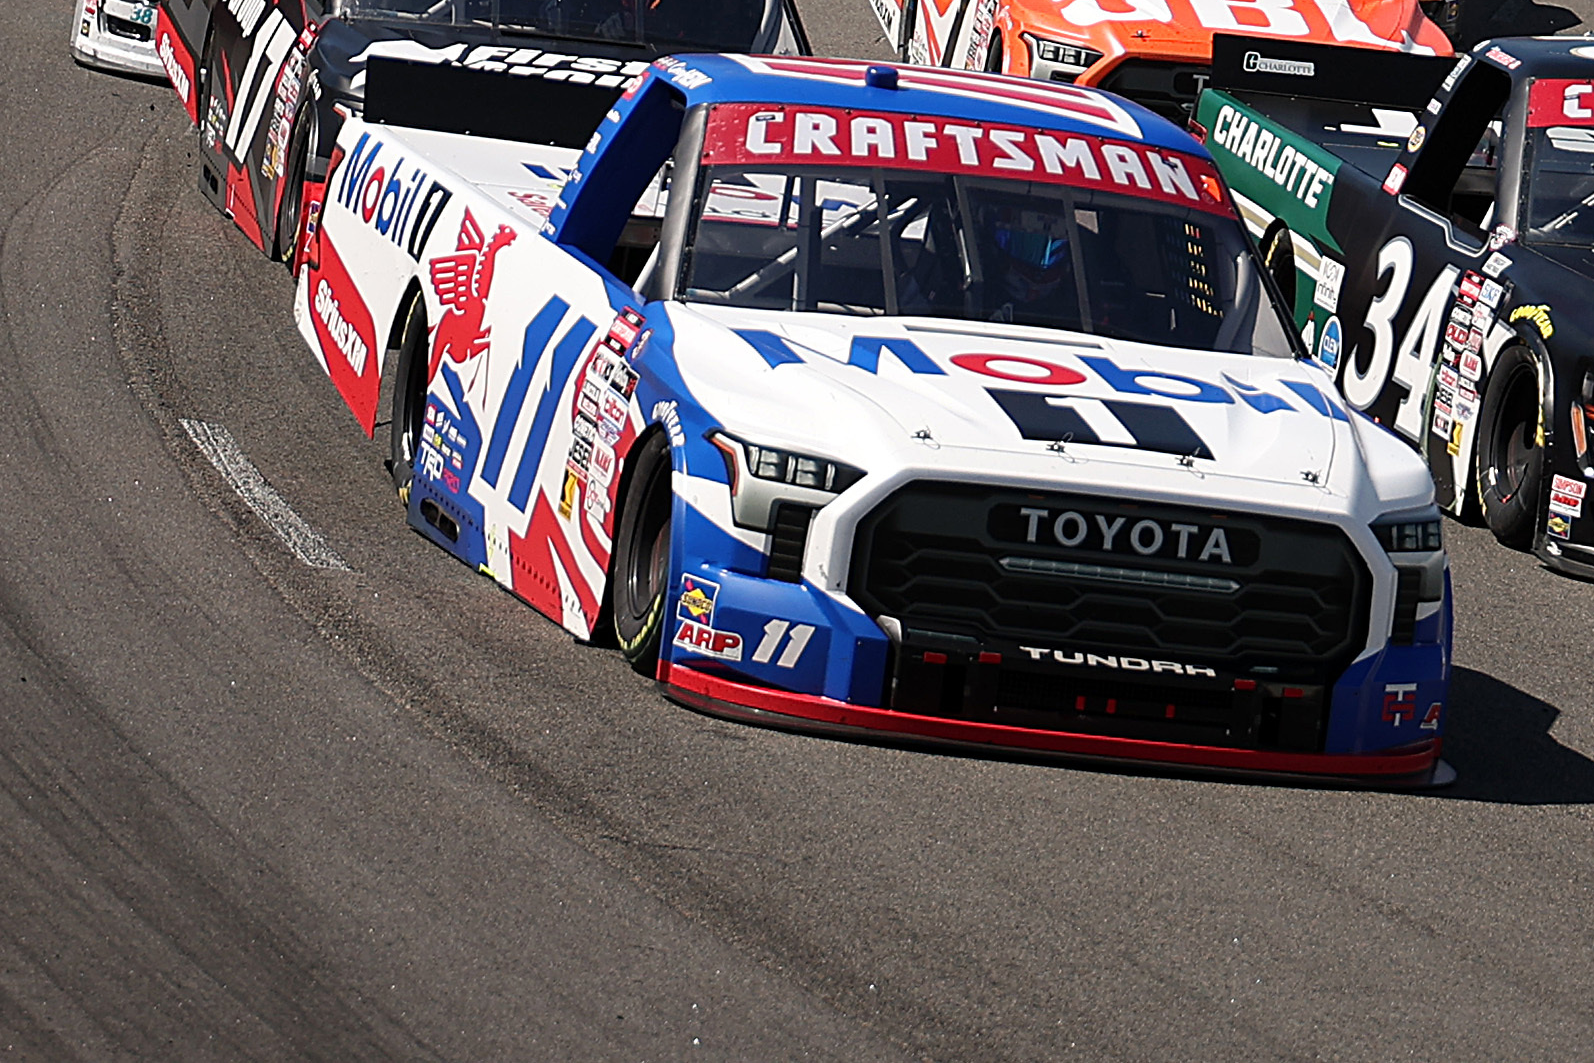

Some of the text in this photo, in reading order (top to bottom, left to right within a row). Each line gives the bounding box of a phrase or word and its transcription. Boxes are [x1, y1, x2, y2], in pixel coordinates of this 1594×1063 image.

[129, 7, 154, 25] 38
[464, 44, 653, 76] First
[1258, 60, 1315, 77] CHARLOTTE
[224, 7, 300, 165] 17
[744, 111, 1203, 202] CRAFTSMAN
[1212, 103, 1334, 210] CHARLOTTE
[337, 131, 453, 264] Mobil 1
[1481, 282, 1501, 304] SKF
[314, 278, 369, 378] SiriusXM
[1344, 235, 1461, 441] 34
[731, 328, 1352, 424] Mobil
[480, 293, 599, 515] 11
[420, 439, 445, 482] TRD
[1554, 476, 1584, 496] SIMPSON
[1019, 507, 1234, 565] TOYOTA
[680, 592, 714, 614] SUNOCO
[676, 621, 742, 654] ARP
[751, 618, 817, 669] 11
[1018, 644, 1218, 680] TUNDRA
